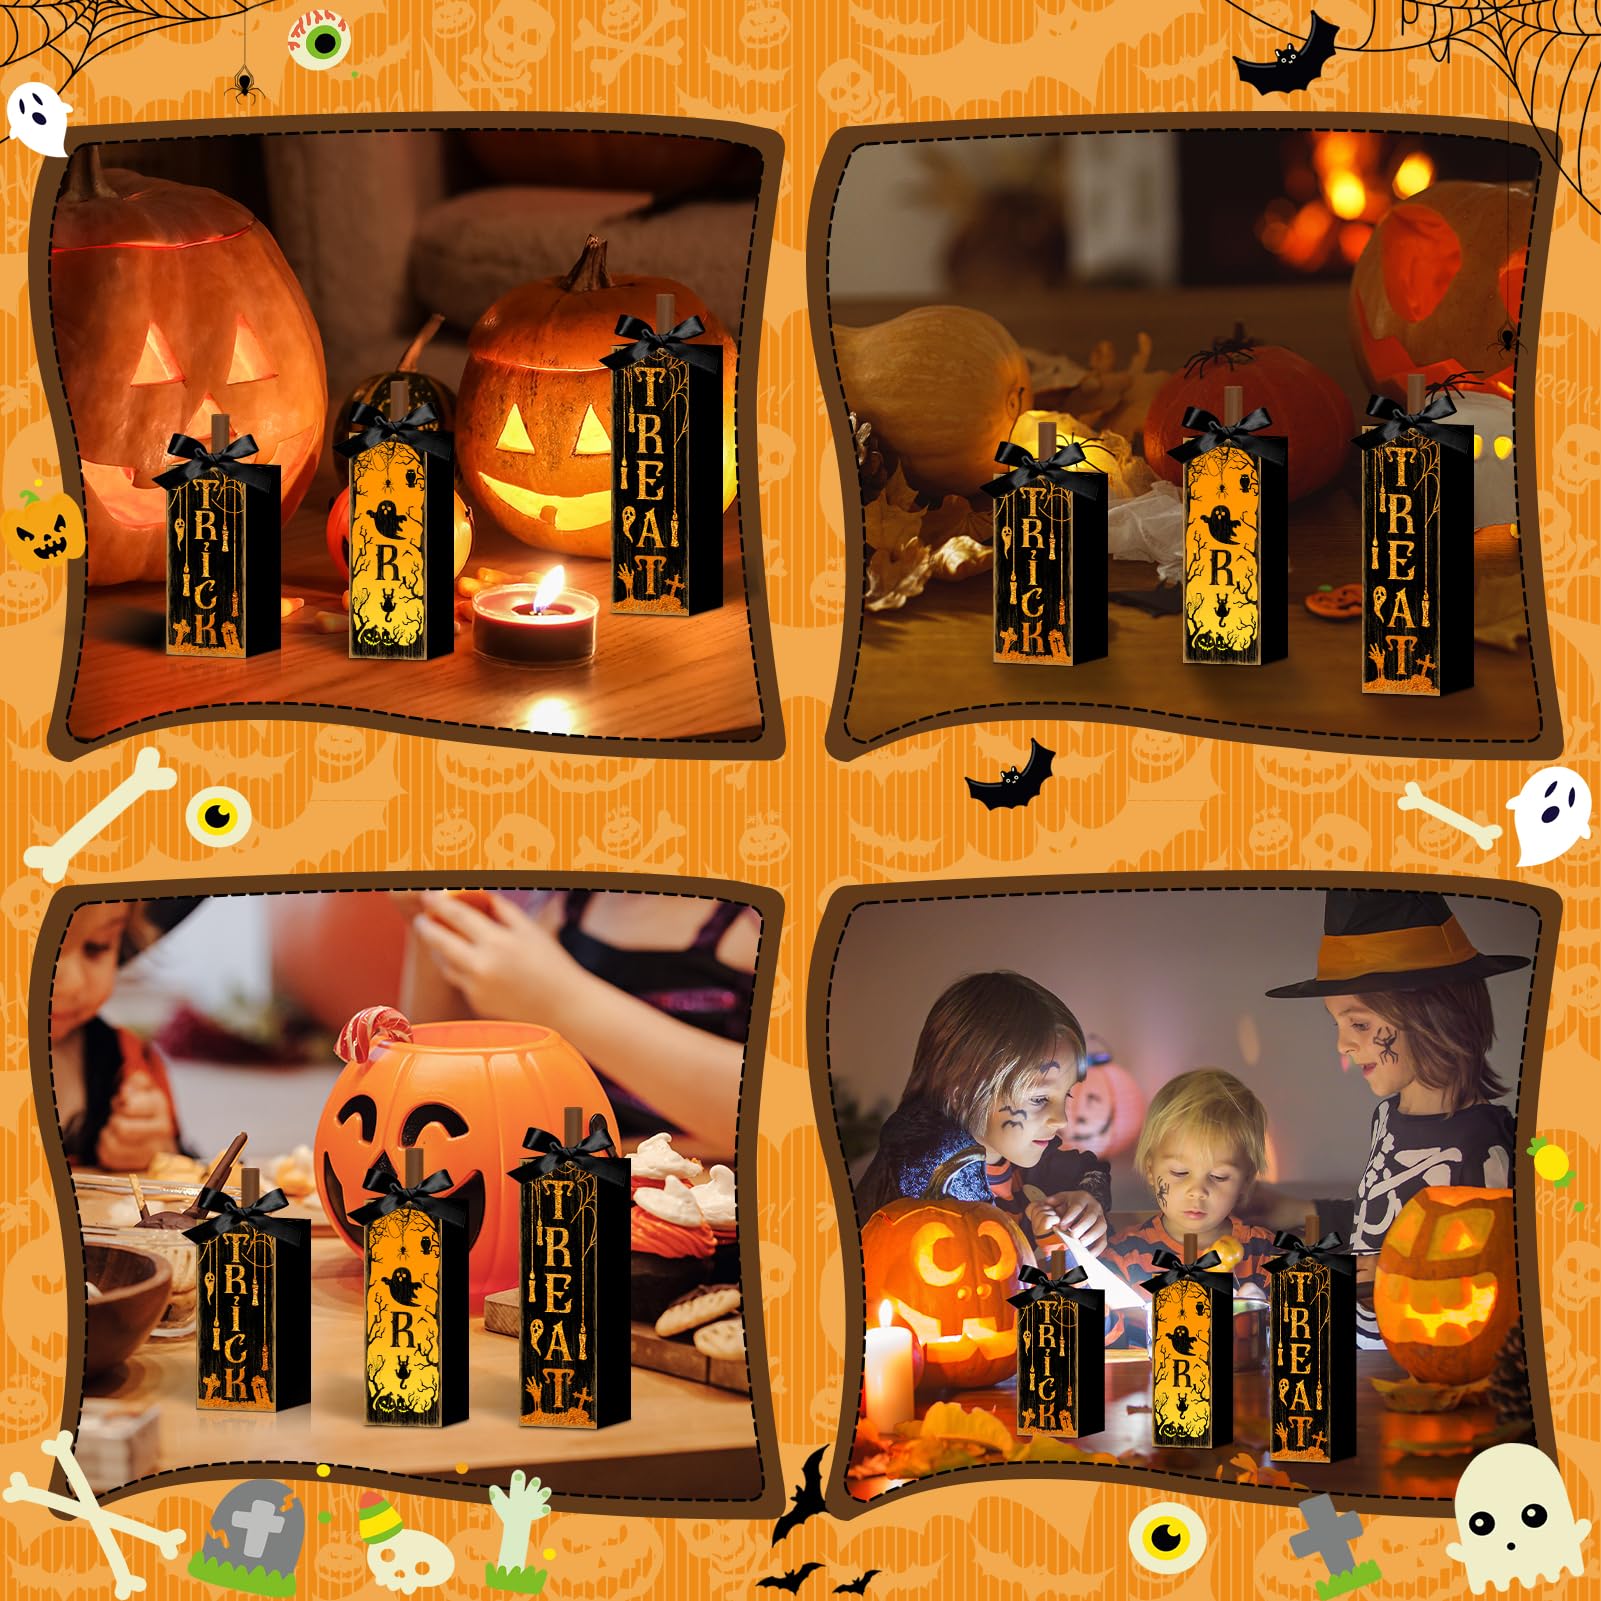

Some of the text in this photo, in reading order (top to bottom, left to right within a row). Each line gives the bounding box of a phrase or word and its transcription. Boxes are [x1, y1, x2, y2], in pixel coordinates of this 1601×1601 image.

[634, 367, 667, 595] TREAT
[1384, 447, 1417, 675] TREAT
[541, 1179, 575, 1408] TREAT
[1287, 1271, 1314, 1447] TREAT
